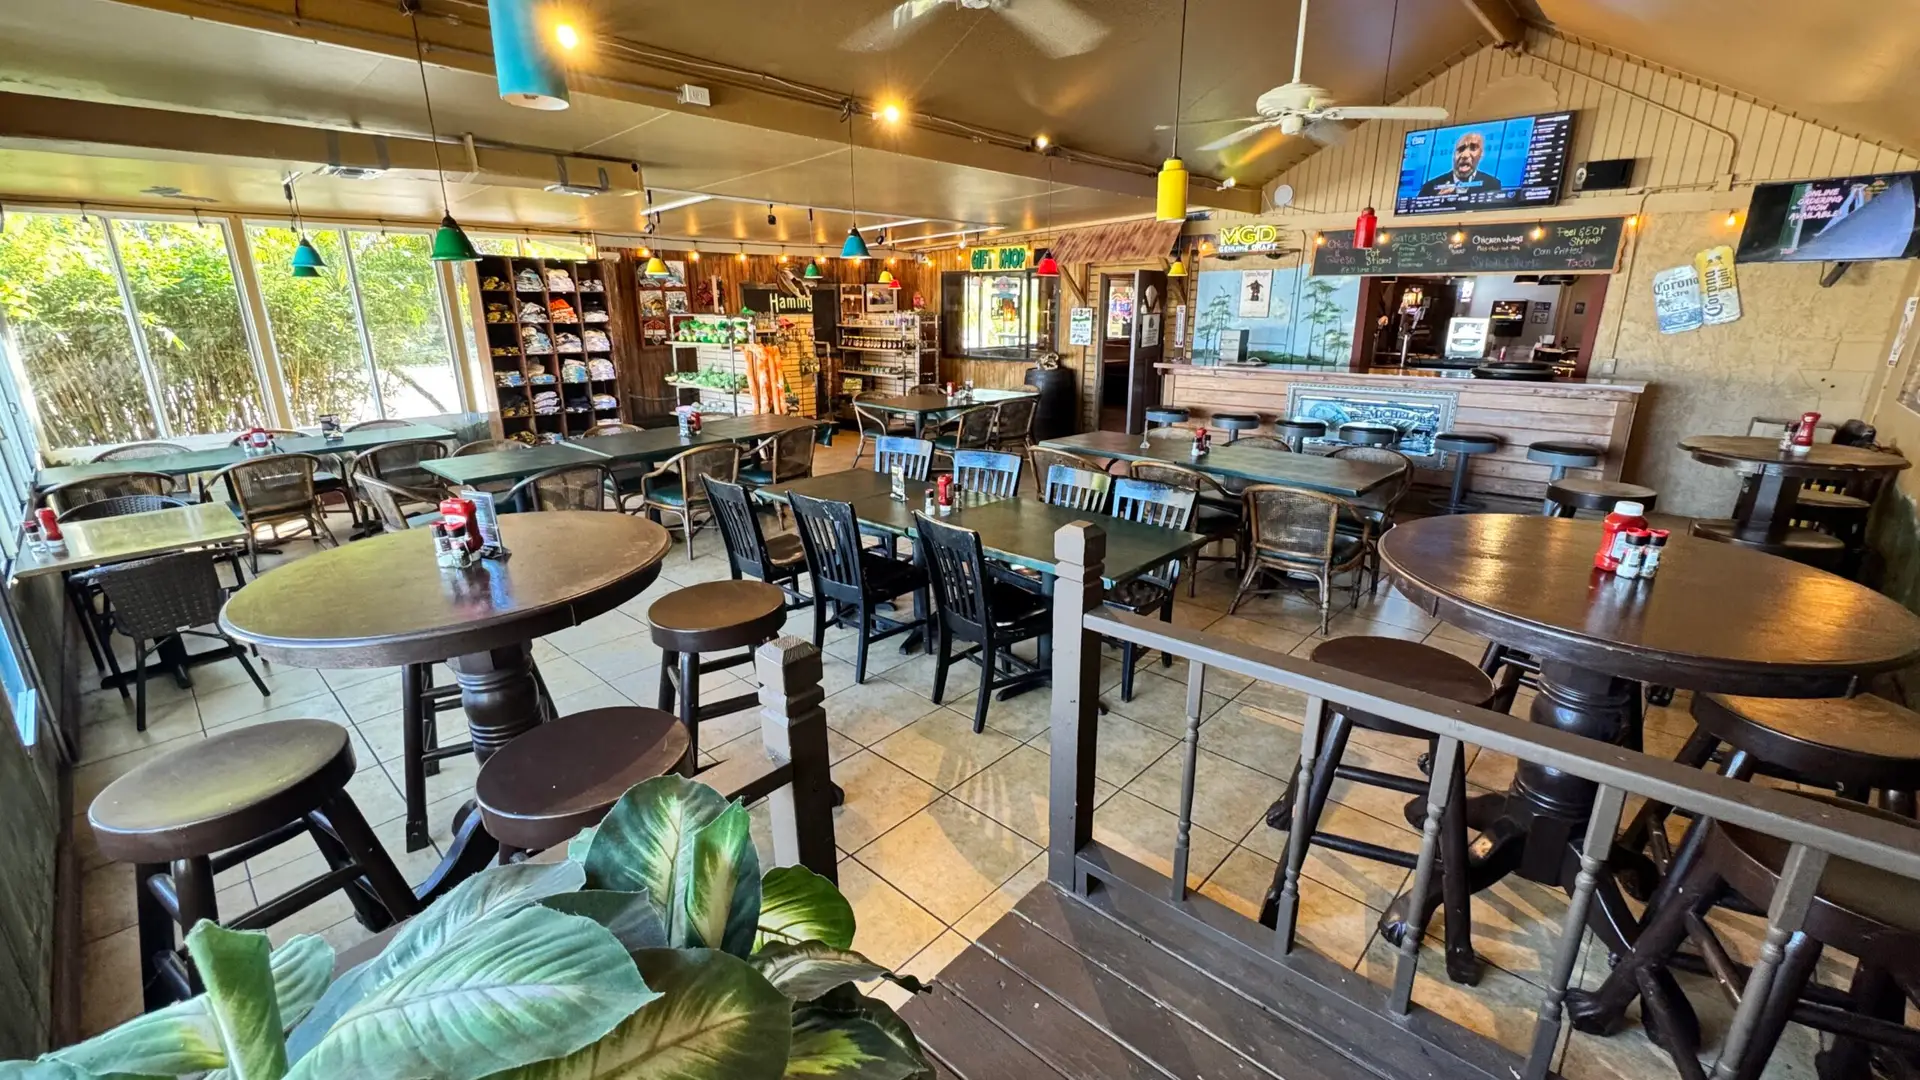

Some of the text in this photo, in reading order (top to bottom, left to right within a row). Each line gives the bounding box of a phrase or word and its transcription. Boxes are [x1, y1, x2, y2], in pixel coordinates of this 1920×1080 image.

[1804, 187, 1841, 196] ONLINE
[1805, 204, 1830, 212] NOW
[1220, 225, 1277, 246] MGD
[1251, 242, 1278, 251] DRAFT
[971, 248, 1026, 270] GIFT SHOP
[1653, 276, 1700, 296] Corona
[1718, 267, 1733, 292] Light
[1665, 290, 1690, 299] Extra
[1704, 270, 1724, 317] Corona
[1369, 408, 1427, 423] MICHELOB
